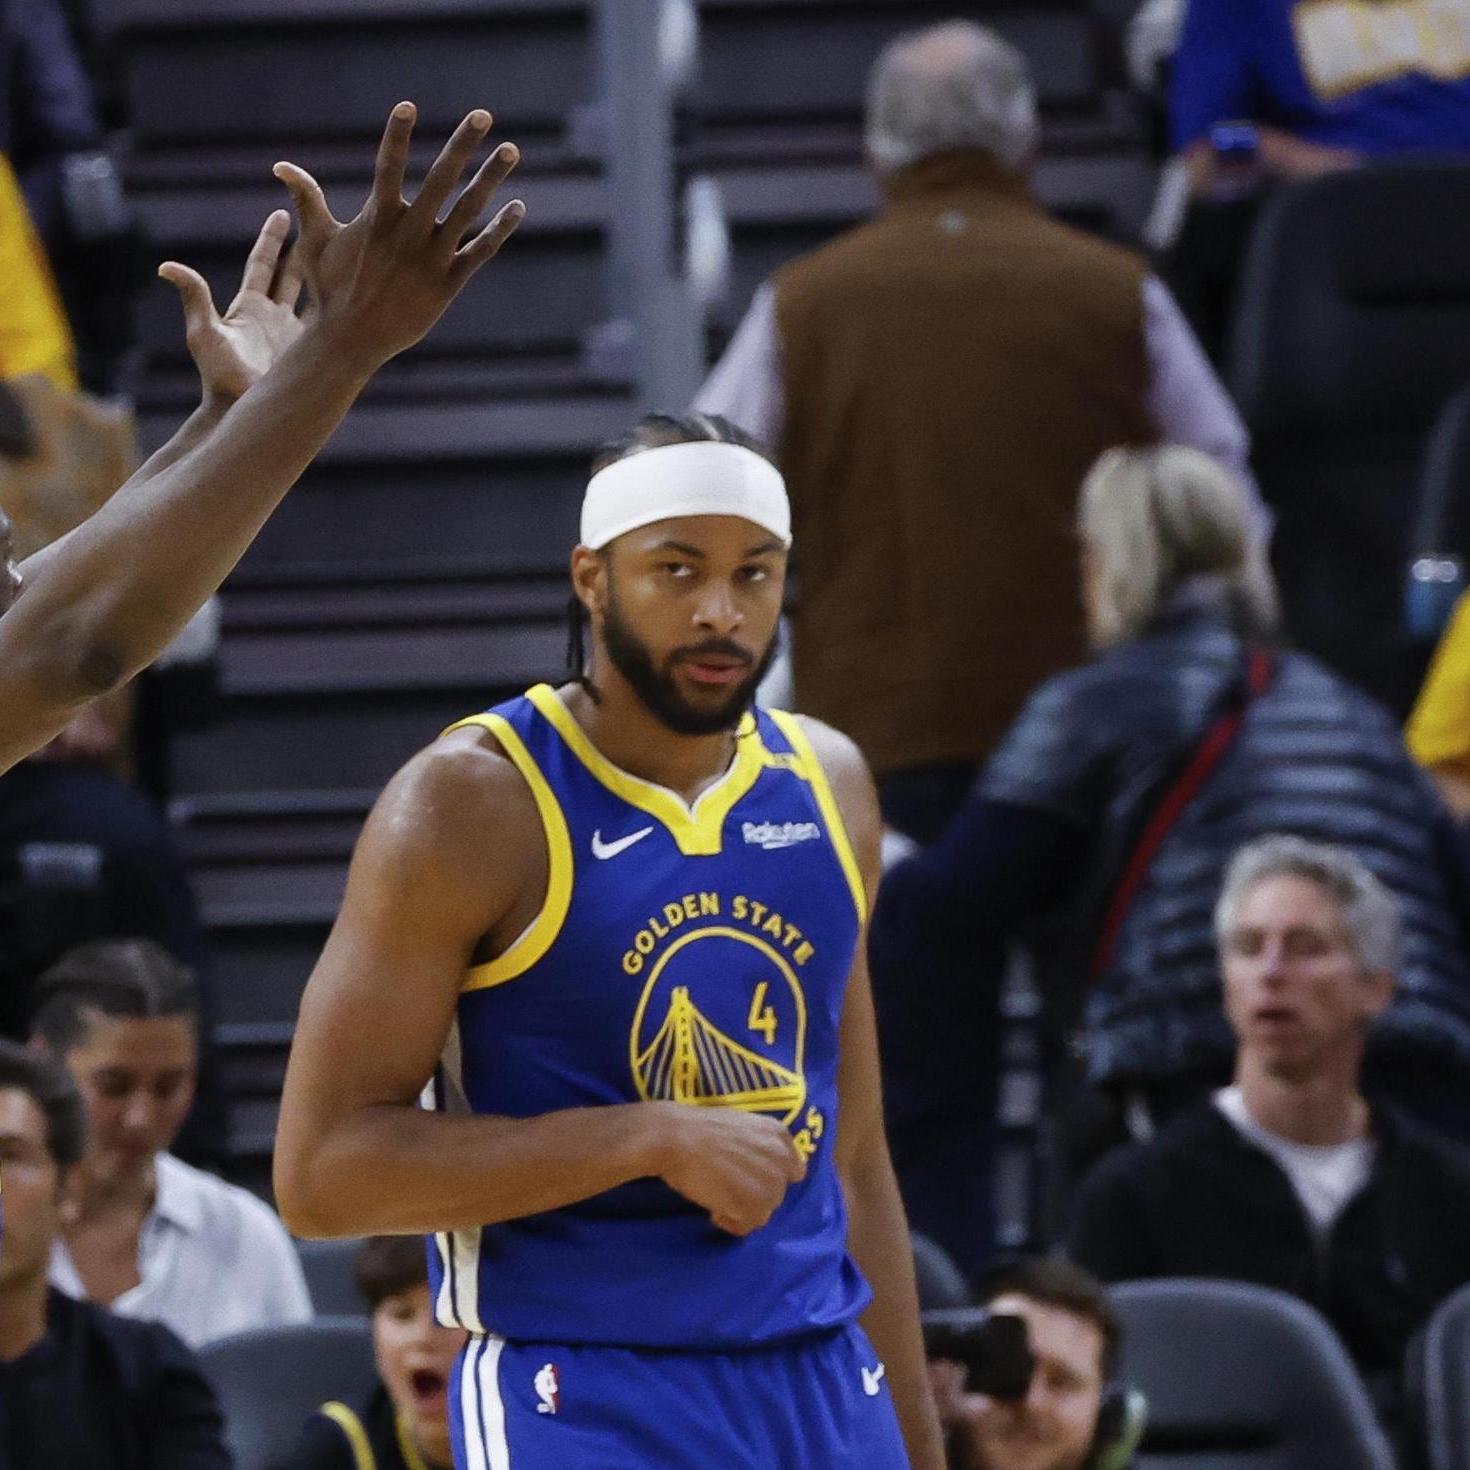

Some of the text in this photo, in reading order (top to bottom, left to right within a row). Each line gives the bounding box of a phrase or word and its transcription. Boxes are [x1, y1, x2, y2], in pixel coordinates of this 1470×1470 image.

[622, 892, 815, 976] GOLDEN STATE
[747, 981, 778, 1045] 4
